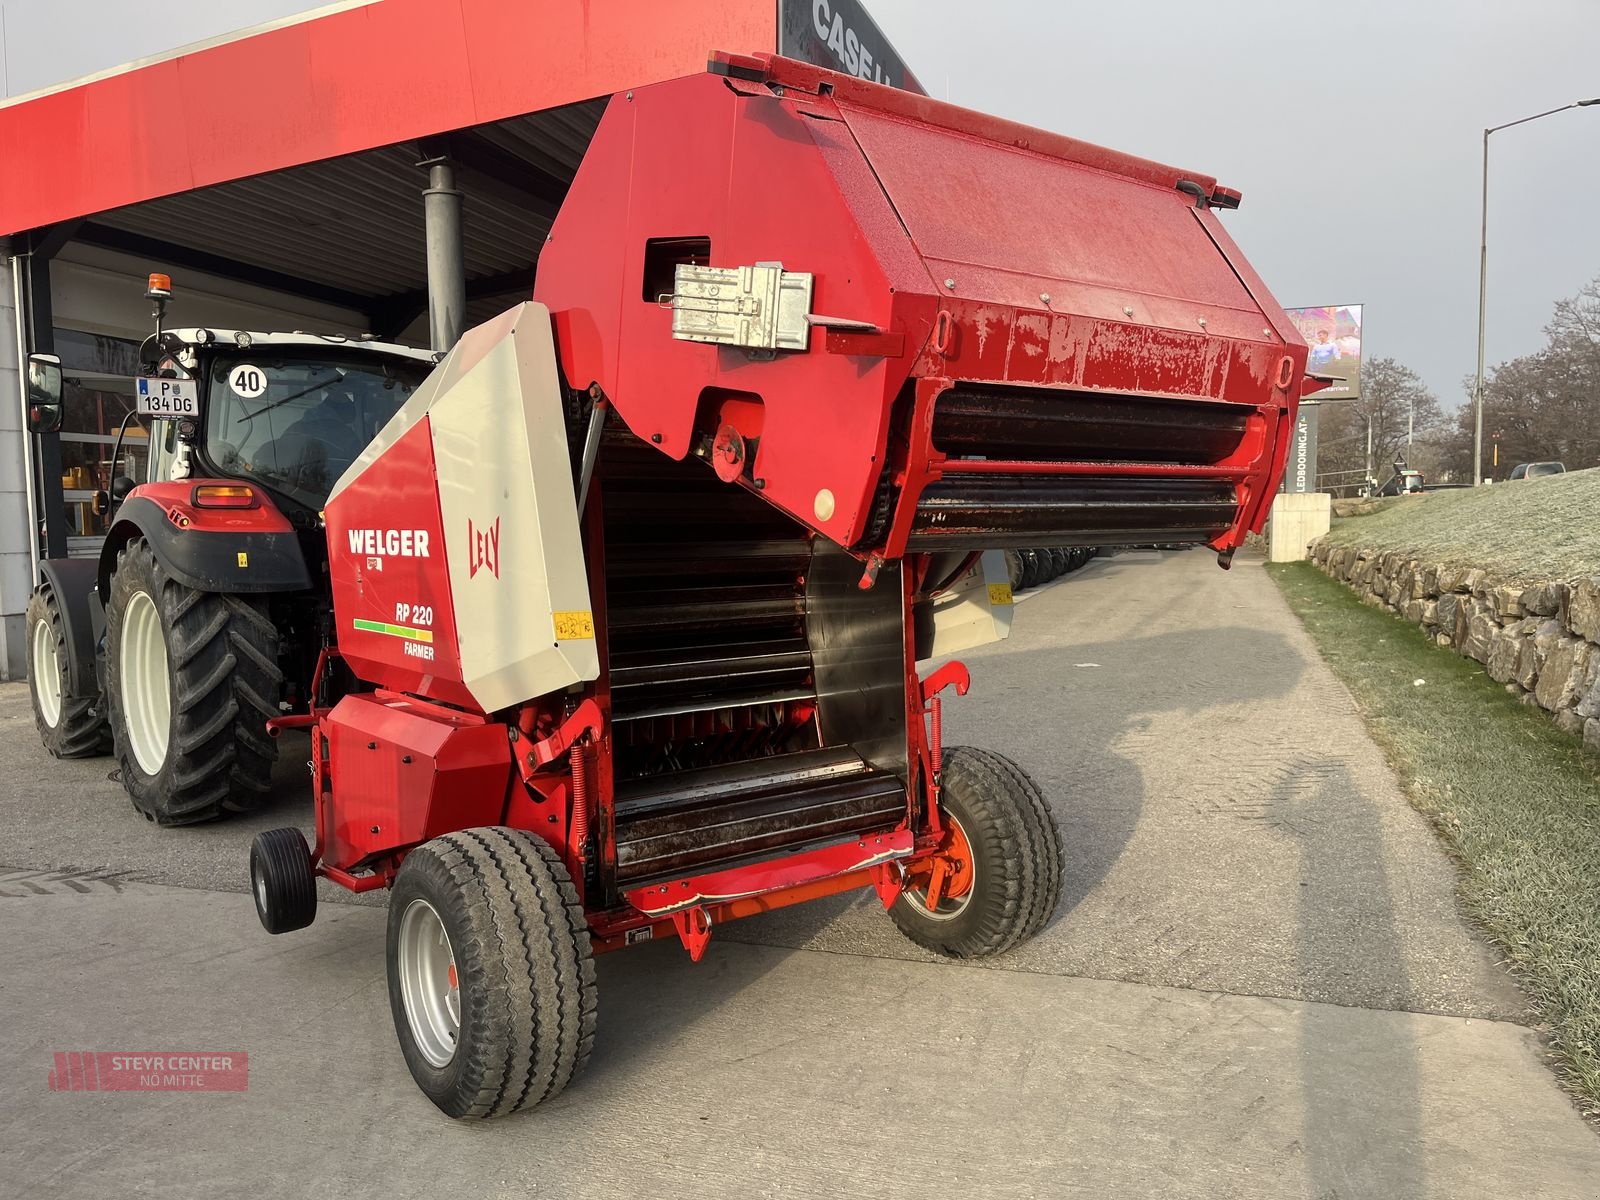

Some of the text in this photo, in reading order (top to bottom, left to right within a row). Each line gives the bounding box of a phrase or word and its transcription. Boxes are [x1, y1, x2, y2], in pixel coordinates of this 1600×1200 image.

[161, 382, 170, 396] P
[235, 371, 260, 392] 40
[144, 396, 192, 412] 134 DG
[1296, 421, 1308, 493] LEDBOOKING.AT
[348, 529, 430, 557] WELGER
[468, 515, 500, 581] LELY
[395, 602, 433, 626] RP 220
[404, 641, 434, 661] FARMER
